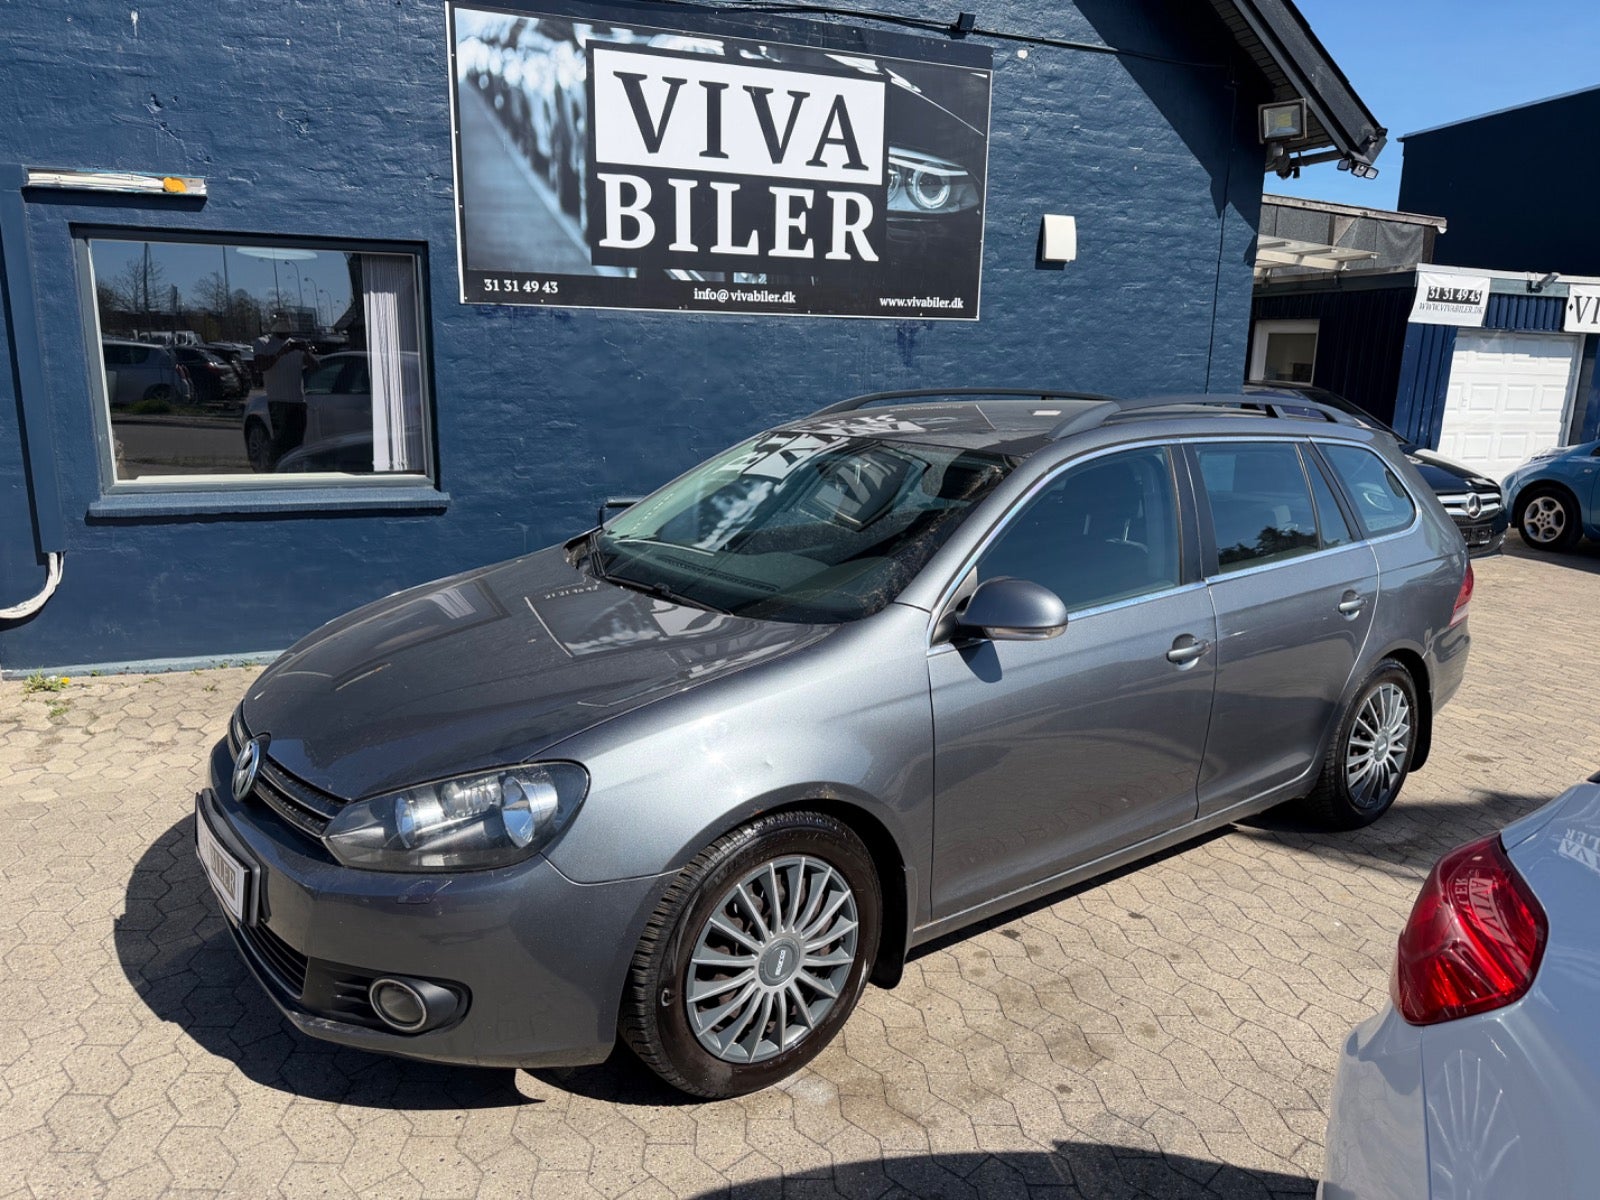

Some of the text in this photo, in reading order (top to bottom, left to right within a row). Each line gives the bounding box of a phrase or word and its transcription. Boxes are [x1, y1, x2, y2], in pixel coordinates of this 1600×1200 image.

[613, 71, 869, 171] VIVA
[597, 173, 879, 262] BILER
[484, 279, 559, 294] 31 31 49 43
[1429, 287, 1481, 302] 31 31 49 43
[880, 296, 964, 309] www.vivabiler.dk
